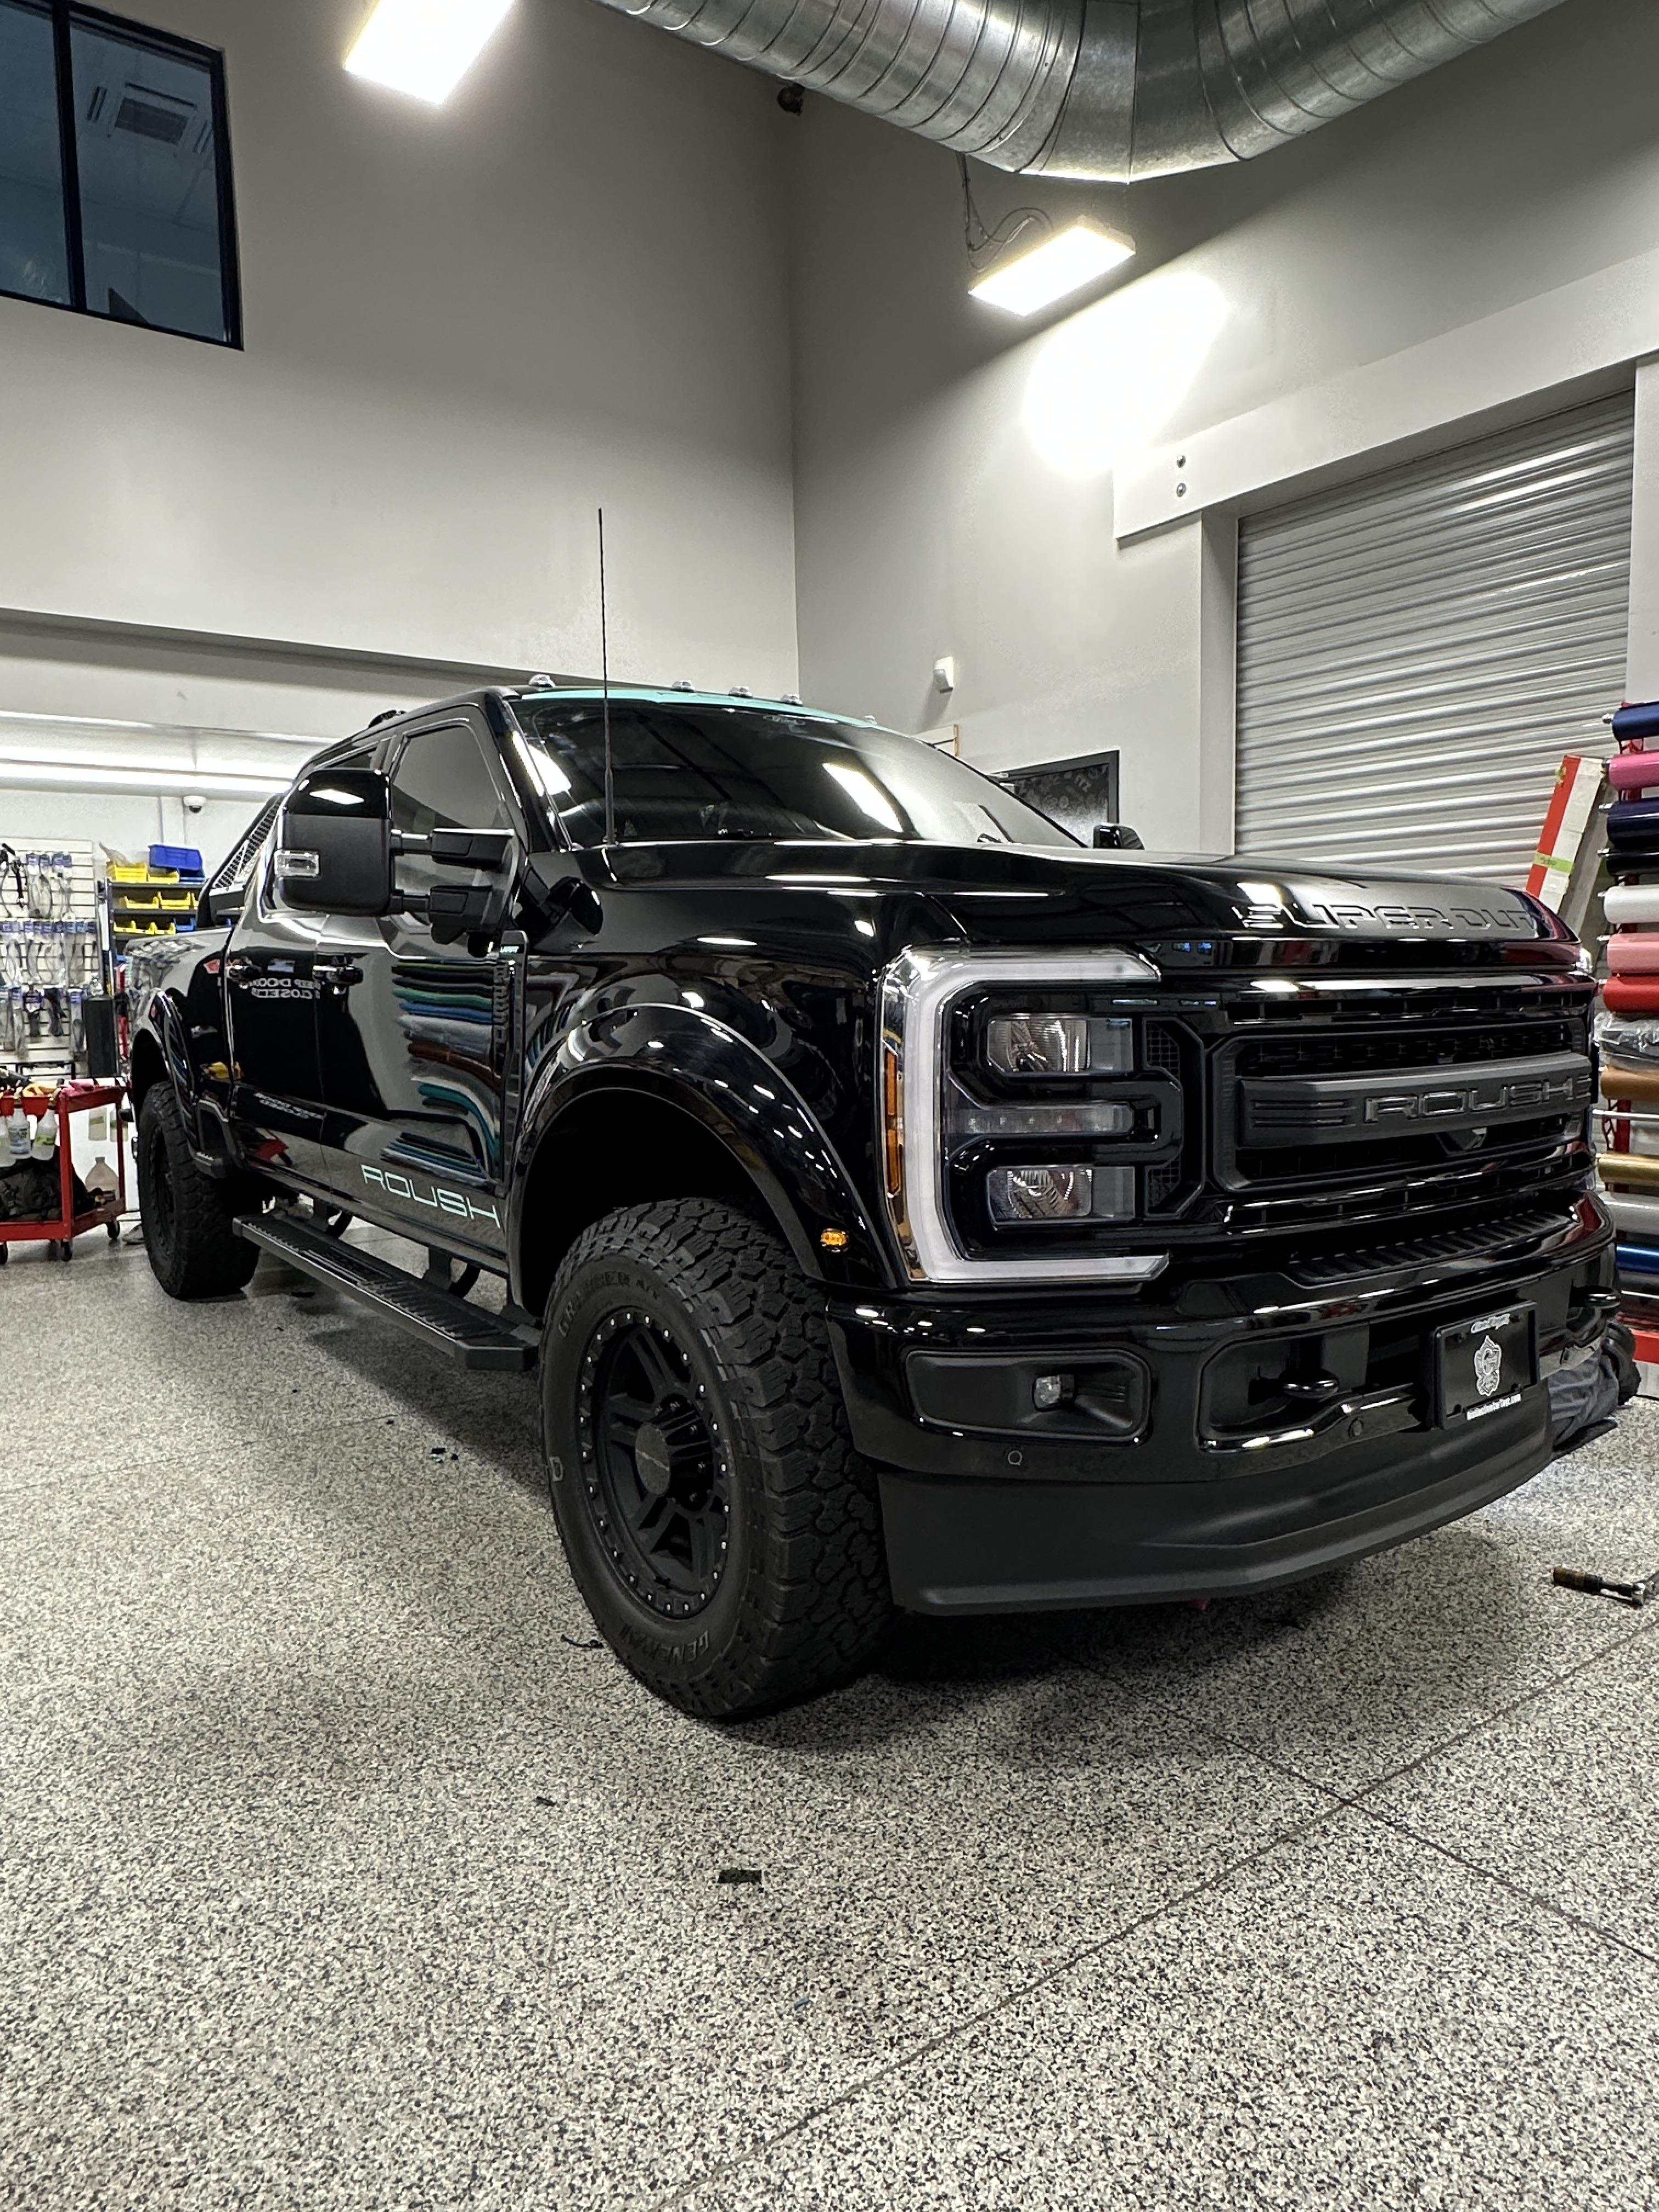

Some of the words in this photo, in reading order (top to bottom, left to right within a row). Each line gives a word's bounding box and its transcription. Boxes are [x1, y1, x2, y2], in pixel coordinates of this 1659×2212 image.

[1231, 903, 1455, 930] SUPER
[1449, 907, 1544, 932] DUT
[1364, 1076, 1574, 1124] ROUSH
[361, 1164, 500, 1229] ROUSH
[619, 1623, 710, 1666] GENERAL
